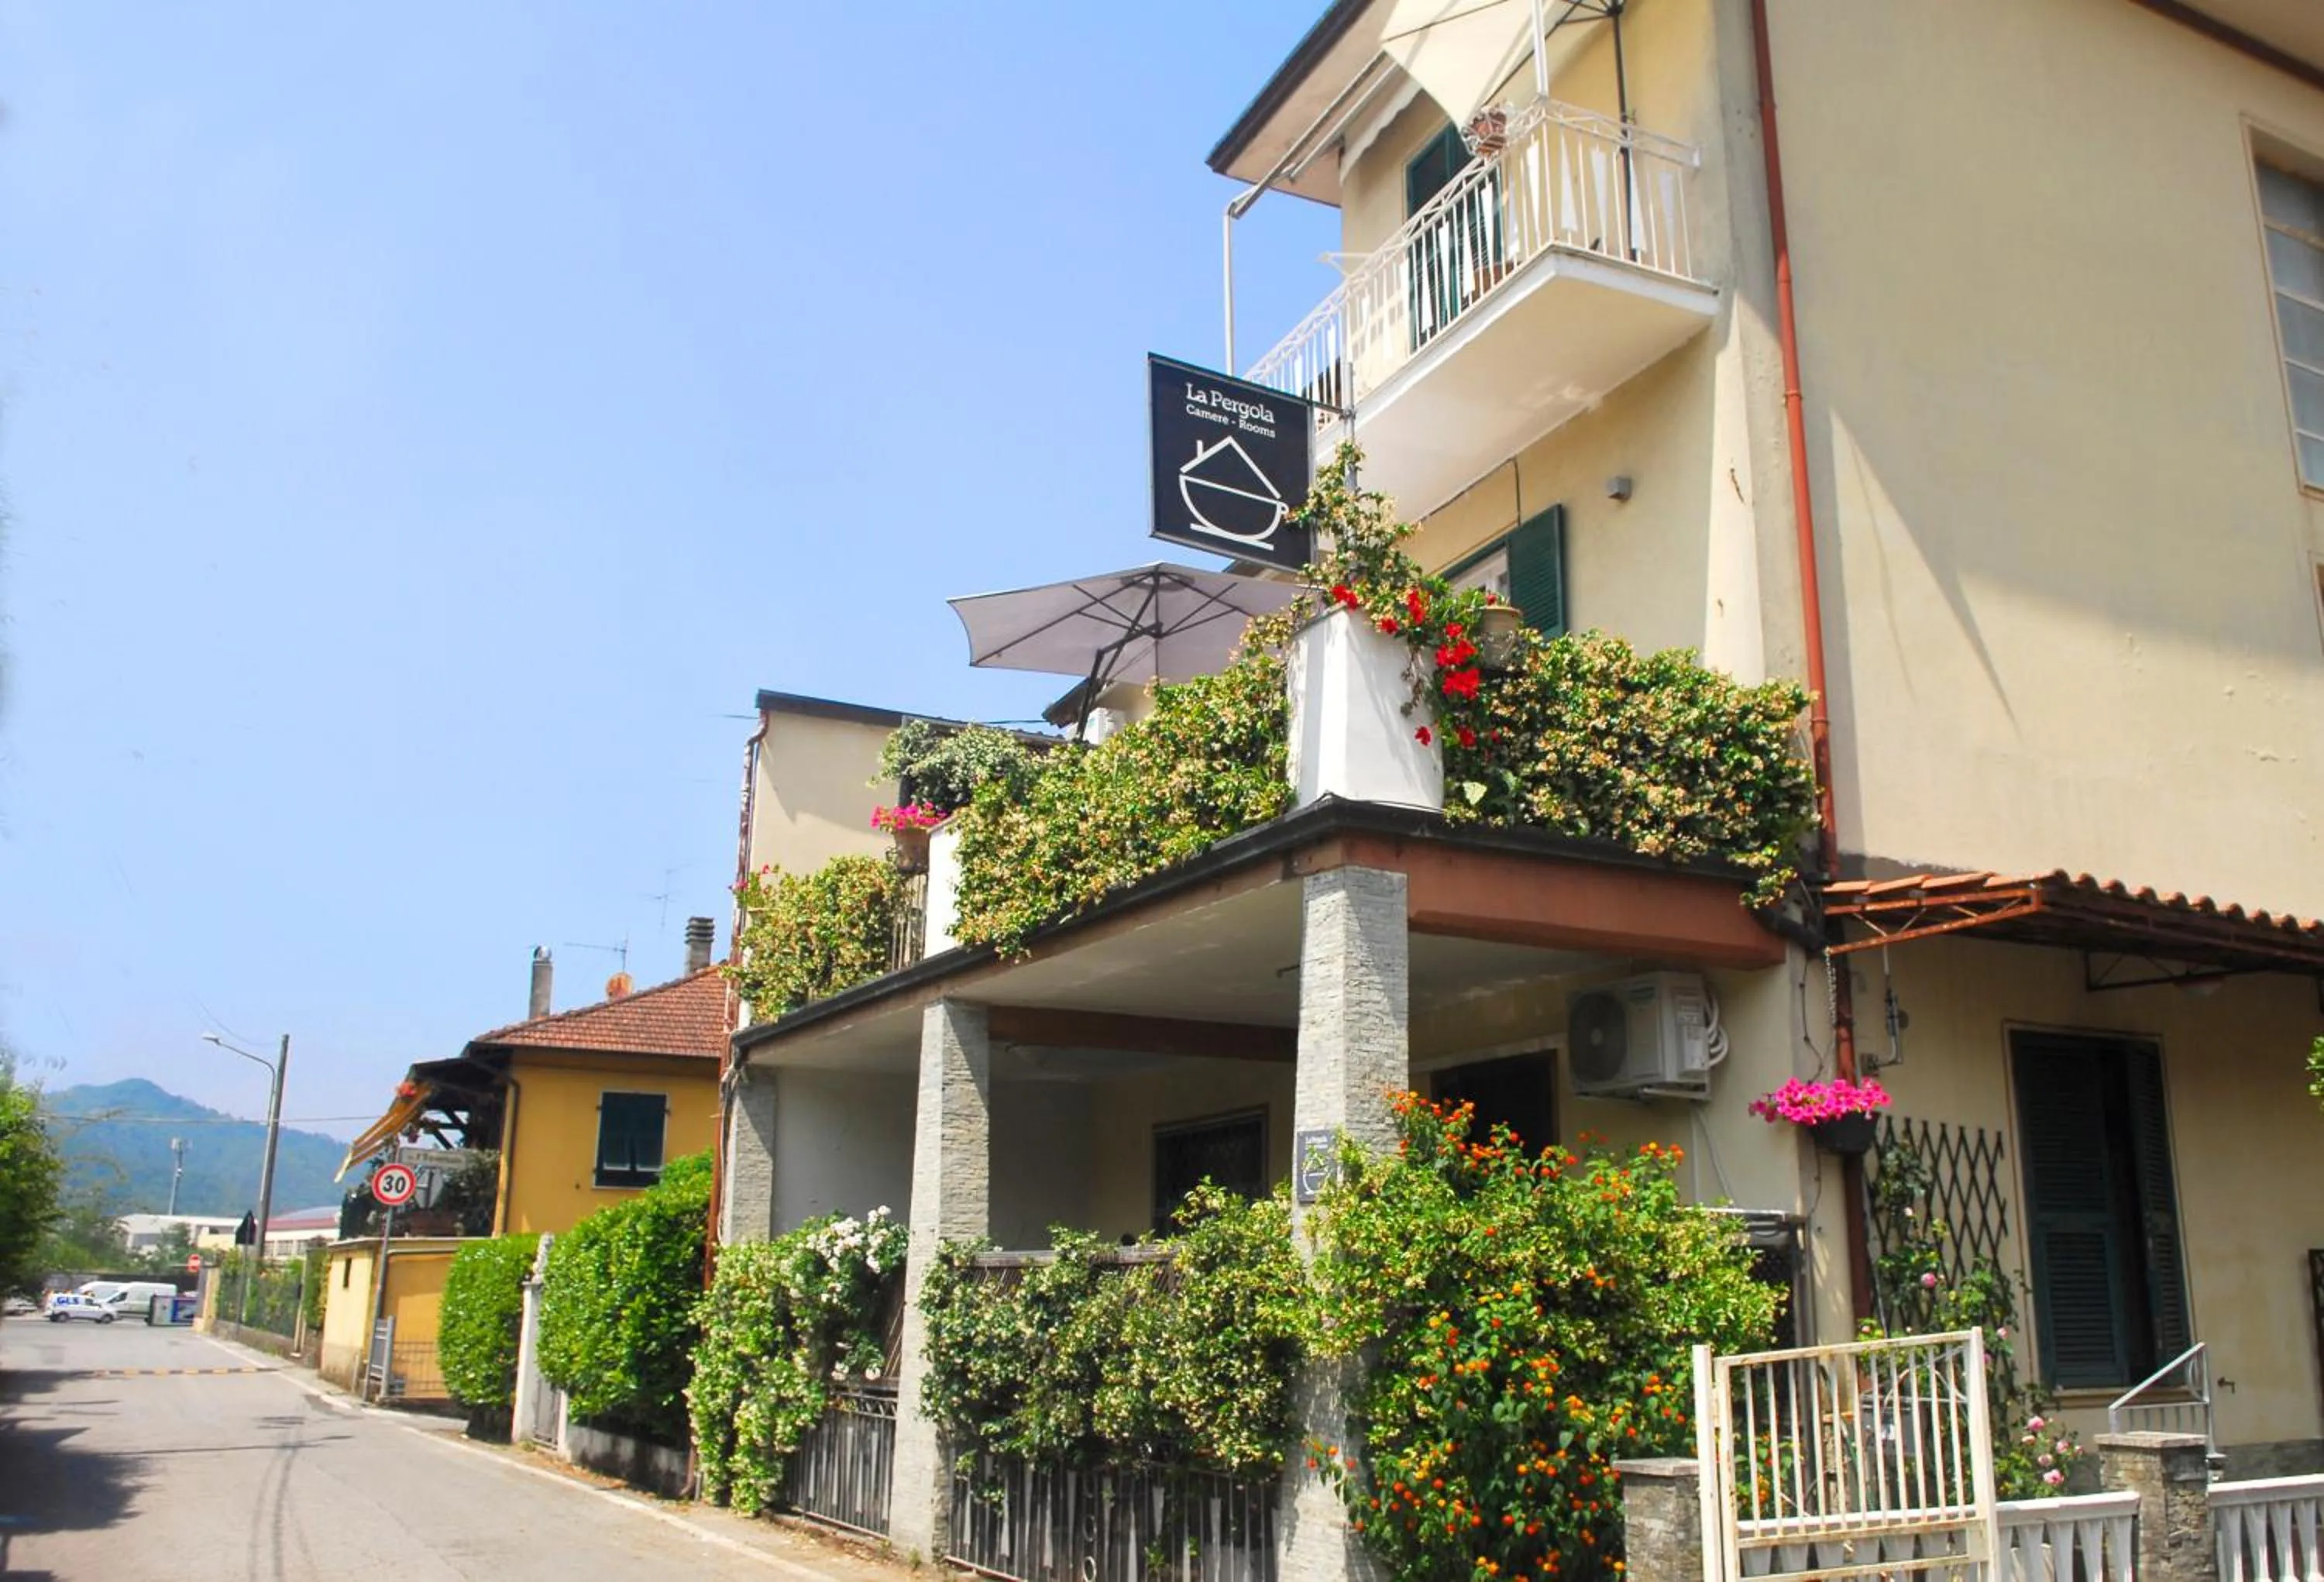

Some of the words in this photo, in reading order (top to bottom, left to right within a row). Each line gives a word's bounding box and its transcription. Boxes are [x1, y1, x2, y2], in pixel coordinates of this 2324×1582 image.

[1186, 383, 1208, 404] La
[1210, 390, 1276, 424] Pergola
[1186, 404, 1229, 425] Camere
[1239, 419, 1276, 438] Rooms
[383, 1174, 407, 1195] 30
[57, 1296, 80, 1305] GLS
